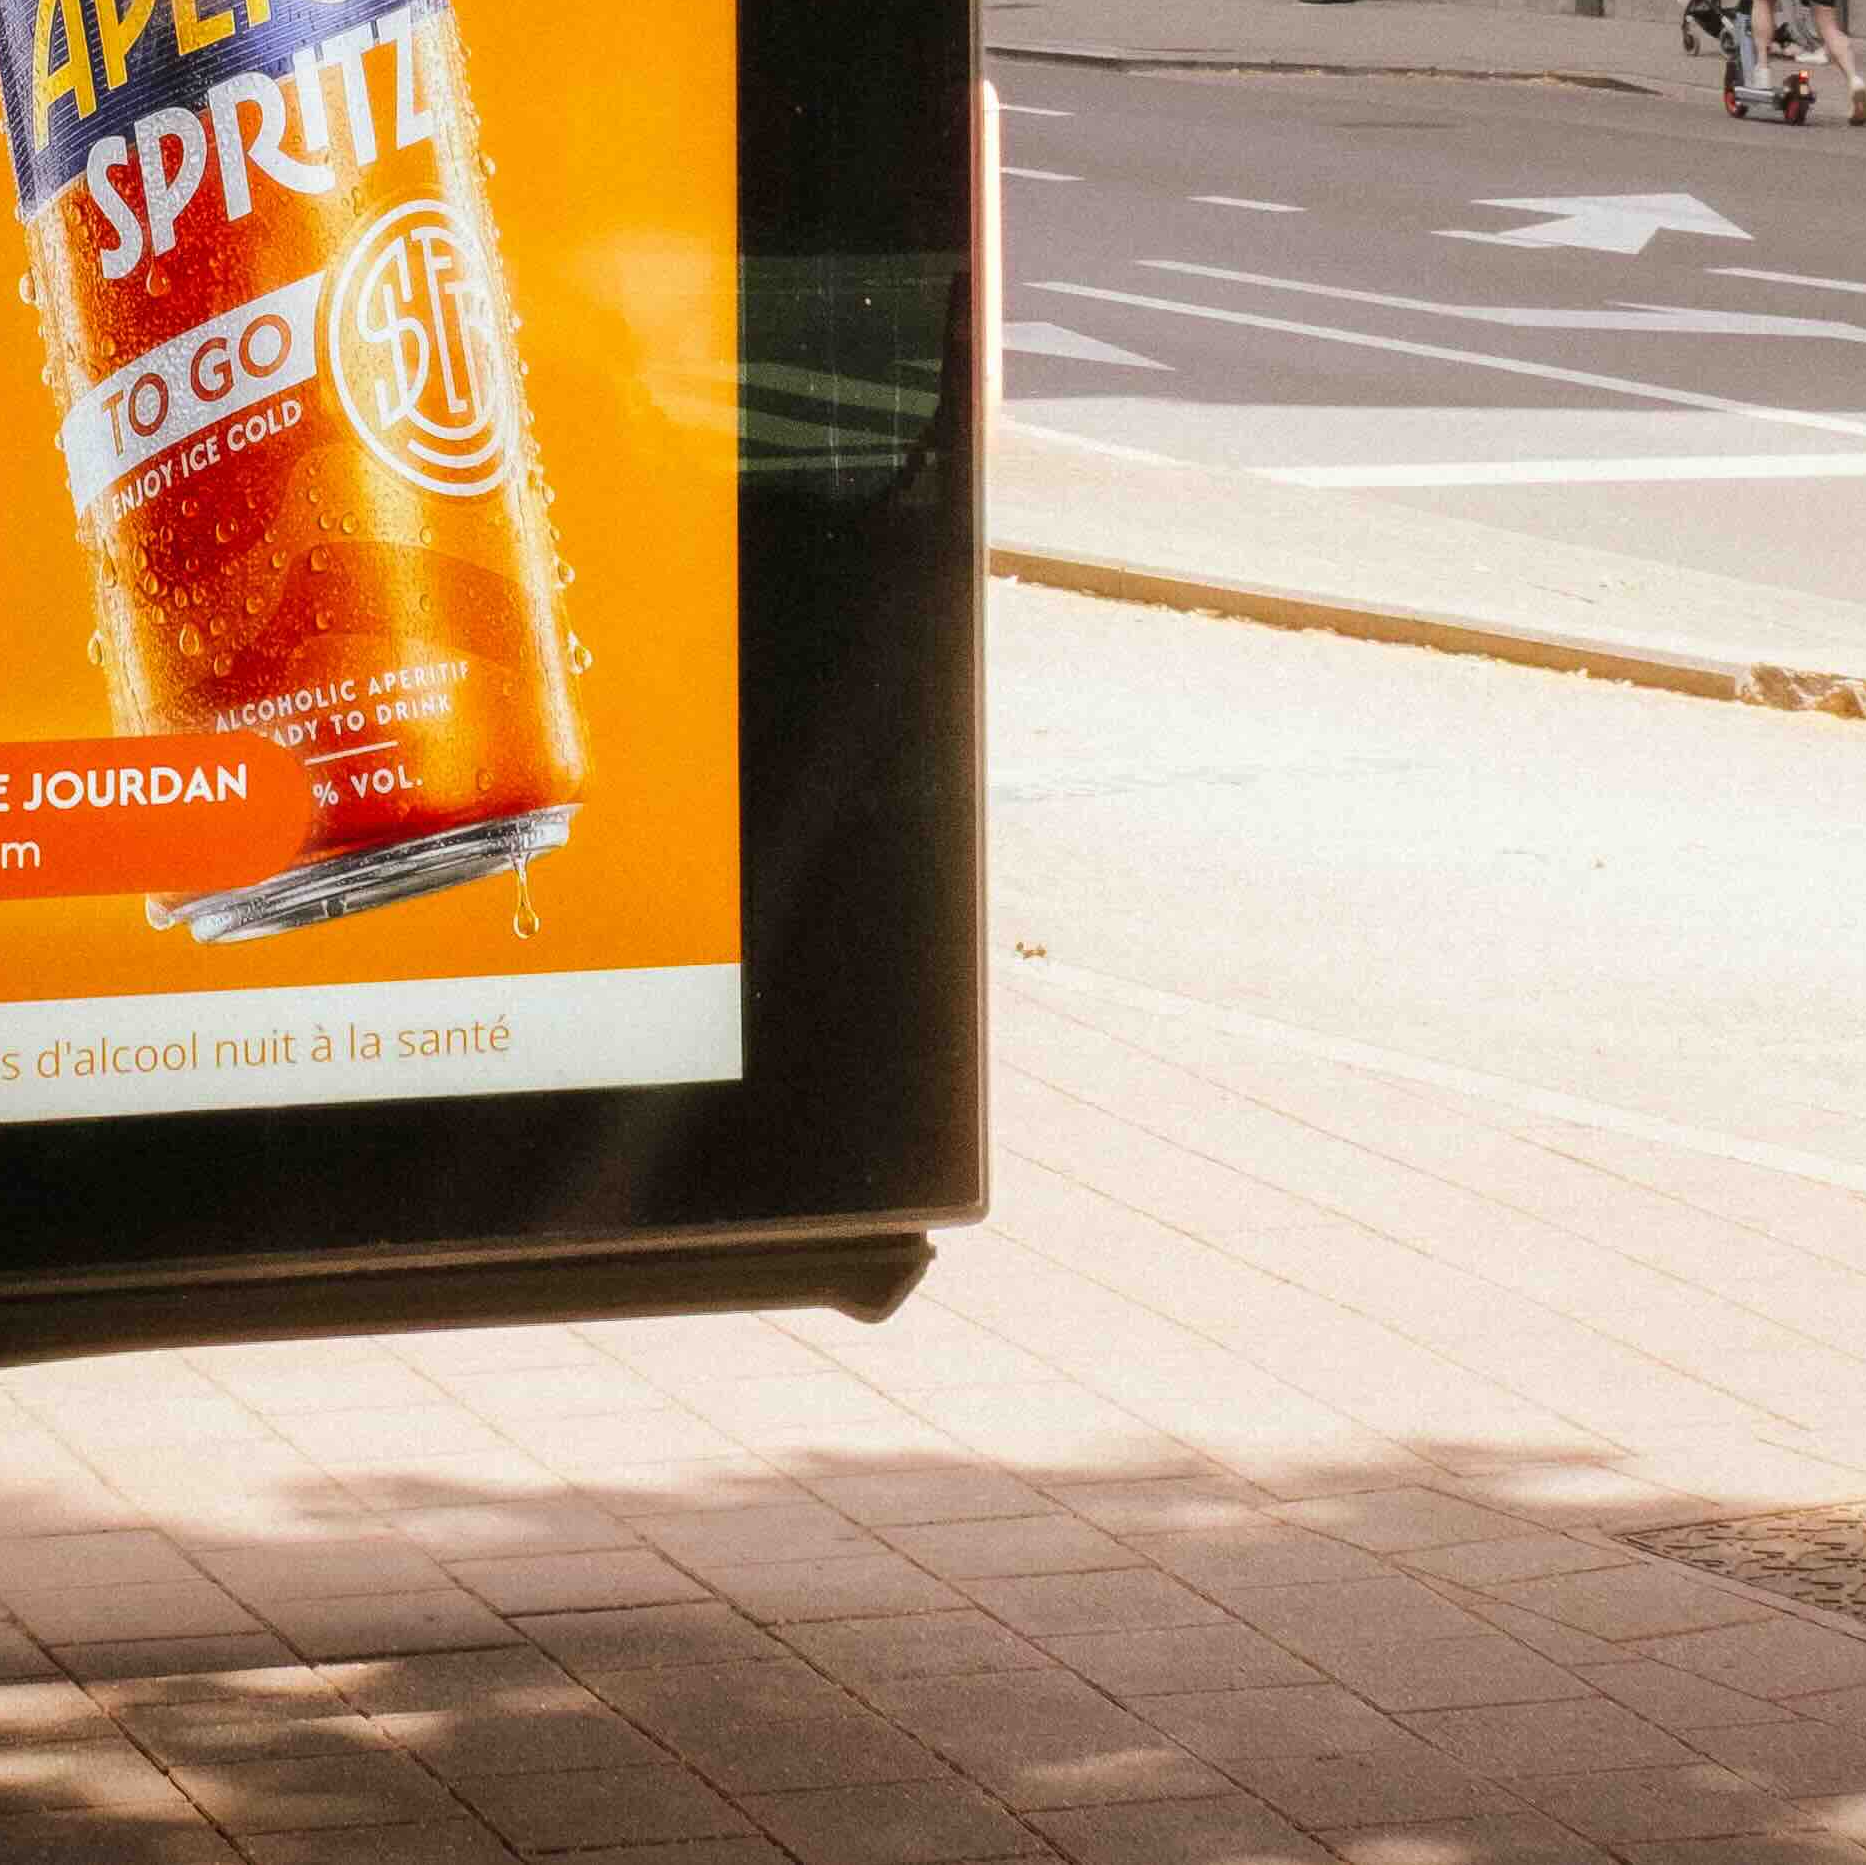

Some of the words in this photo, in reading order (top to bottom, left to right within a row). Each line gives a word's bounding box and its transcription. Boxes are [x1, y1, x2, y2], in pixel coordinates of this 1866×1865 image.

[85, 18, 437, 281] SPRITZ
[103, 372, 169, 458] TO
[191, 314, 293, 402] GO
[111, 460, 173, 521] ENJOY
[181, 435, 221, 478] ICE
[227, 400, 303, 452] COLD
[216, 679, 356, 734] ALCOHOLIC
[368, 661, 469, 696] APERITIF
[259, 718, 318, 748] ADY
[331, 711, 365, 735] TO
[376, 694, 451, 726] DRINK
[22, 763, 247, 811] JOURDAN
[351, 765, 423, 799] VOL.
[36, 1036, 200, 1079] d'alcool
[214, 1031, 296, 1070] nuit
[310, 1022, 333, 1063] à
[349, 1023, 382, 1063] la
[398, 1020, 511, 1058] santé
